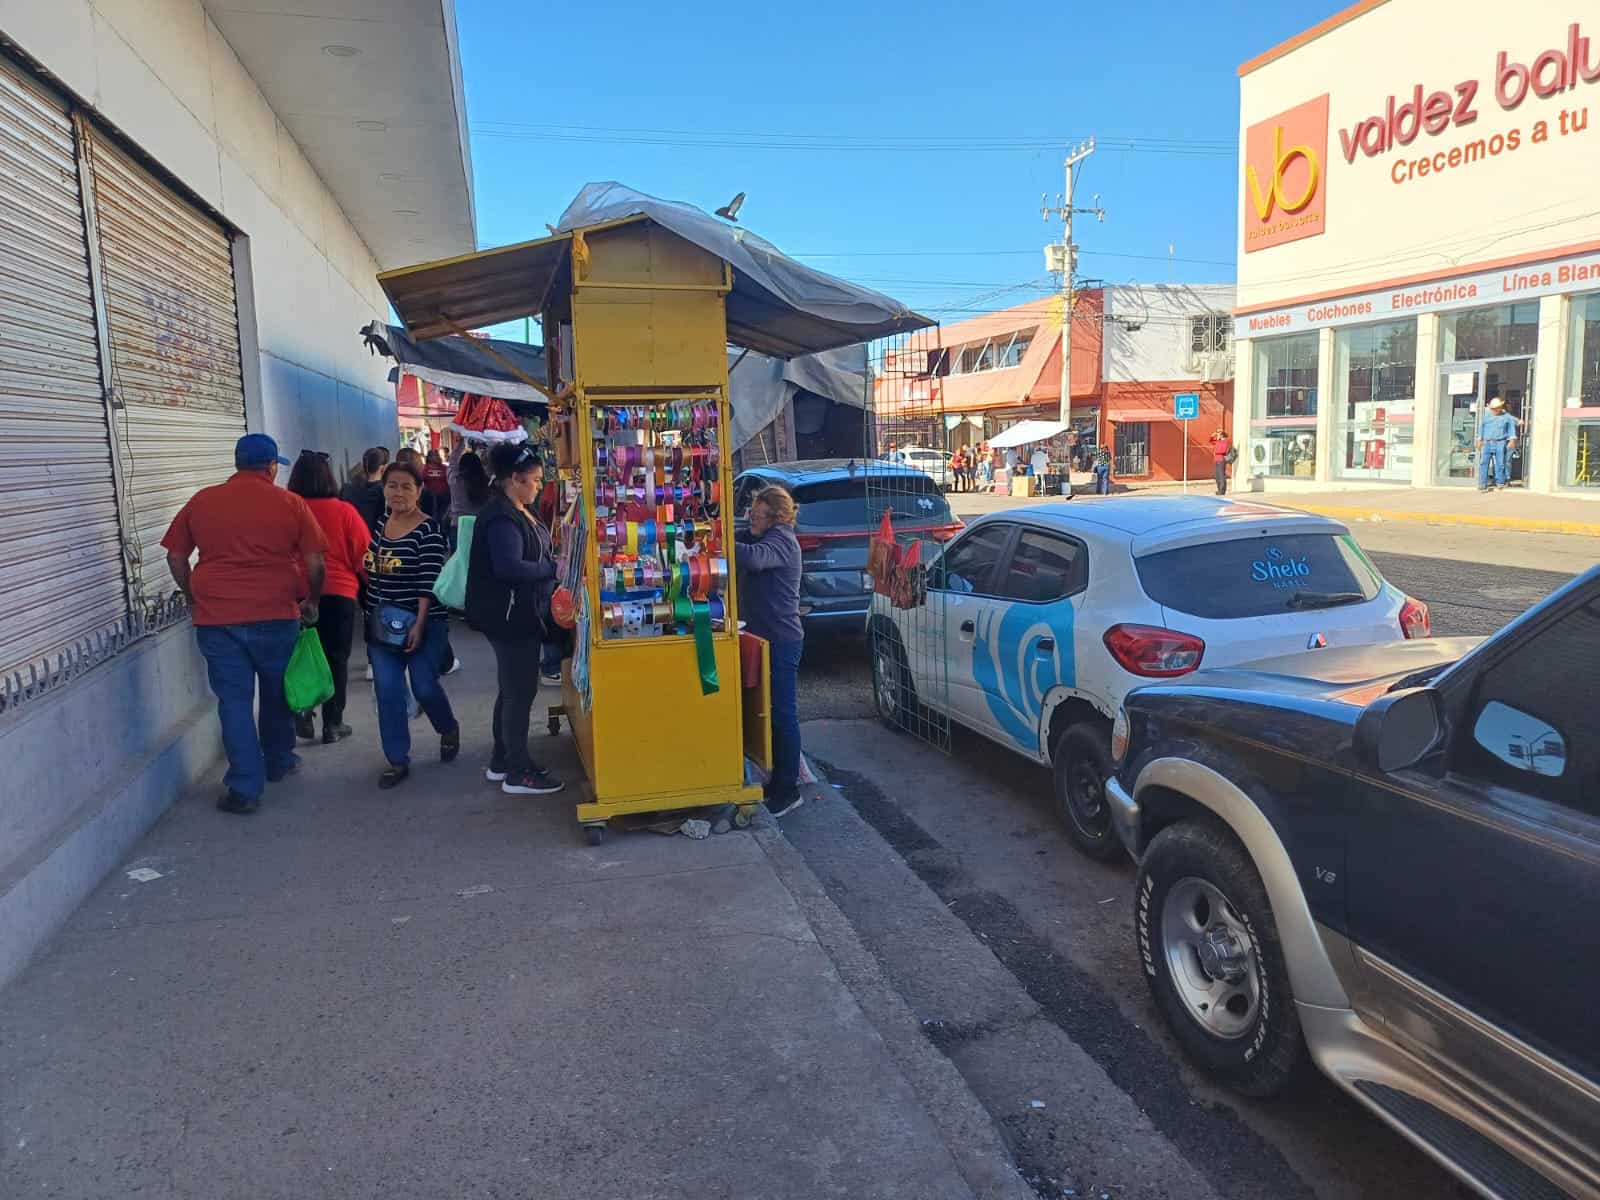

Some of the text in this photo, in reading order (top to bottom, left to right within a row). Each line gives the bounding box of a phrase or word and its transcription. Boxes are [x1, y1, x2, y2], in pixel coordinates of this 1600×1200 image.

[1338, 80, 1479, 165] valdez
[1391, 107, 1588, 184] Crecemos a tu
[1249, 263, 1600, 331] Muebles Colchones Electrónica Línea Blan
[1252, 555, 1310, 581] Sheló
